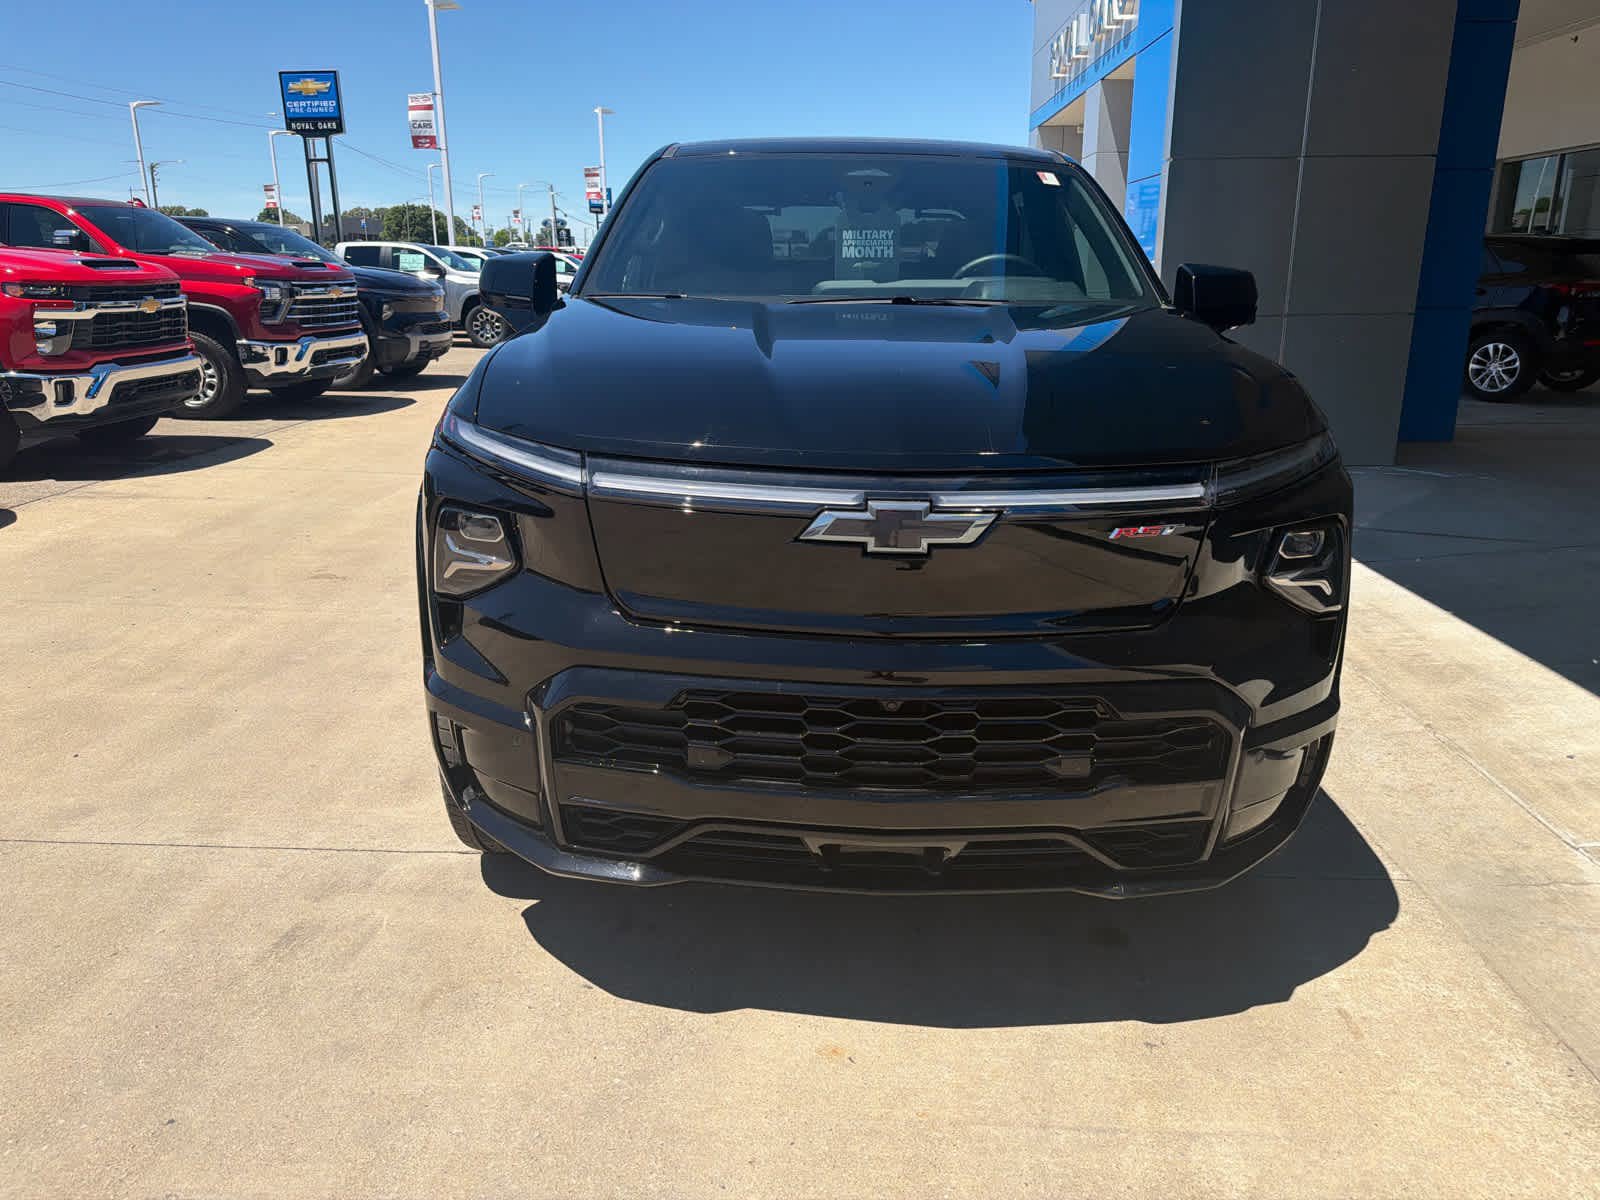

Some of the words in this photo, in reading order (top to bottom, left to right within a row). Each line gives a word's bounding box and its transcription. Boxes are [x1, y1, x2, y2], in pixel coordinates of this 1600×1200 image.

[291, 122, 315, 130] ROYAL
[317, 121, 337, 129] OAKS
[842, 230, 894, 240] MILITARY
[842, 247, 894, 258] MONTH
